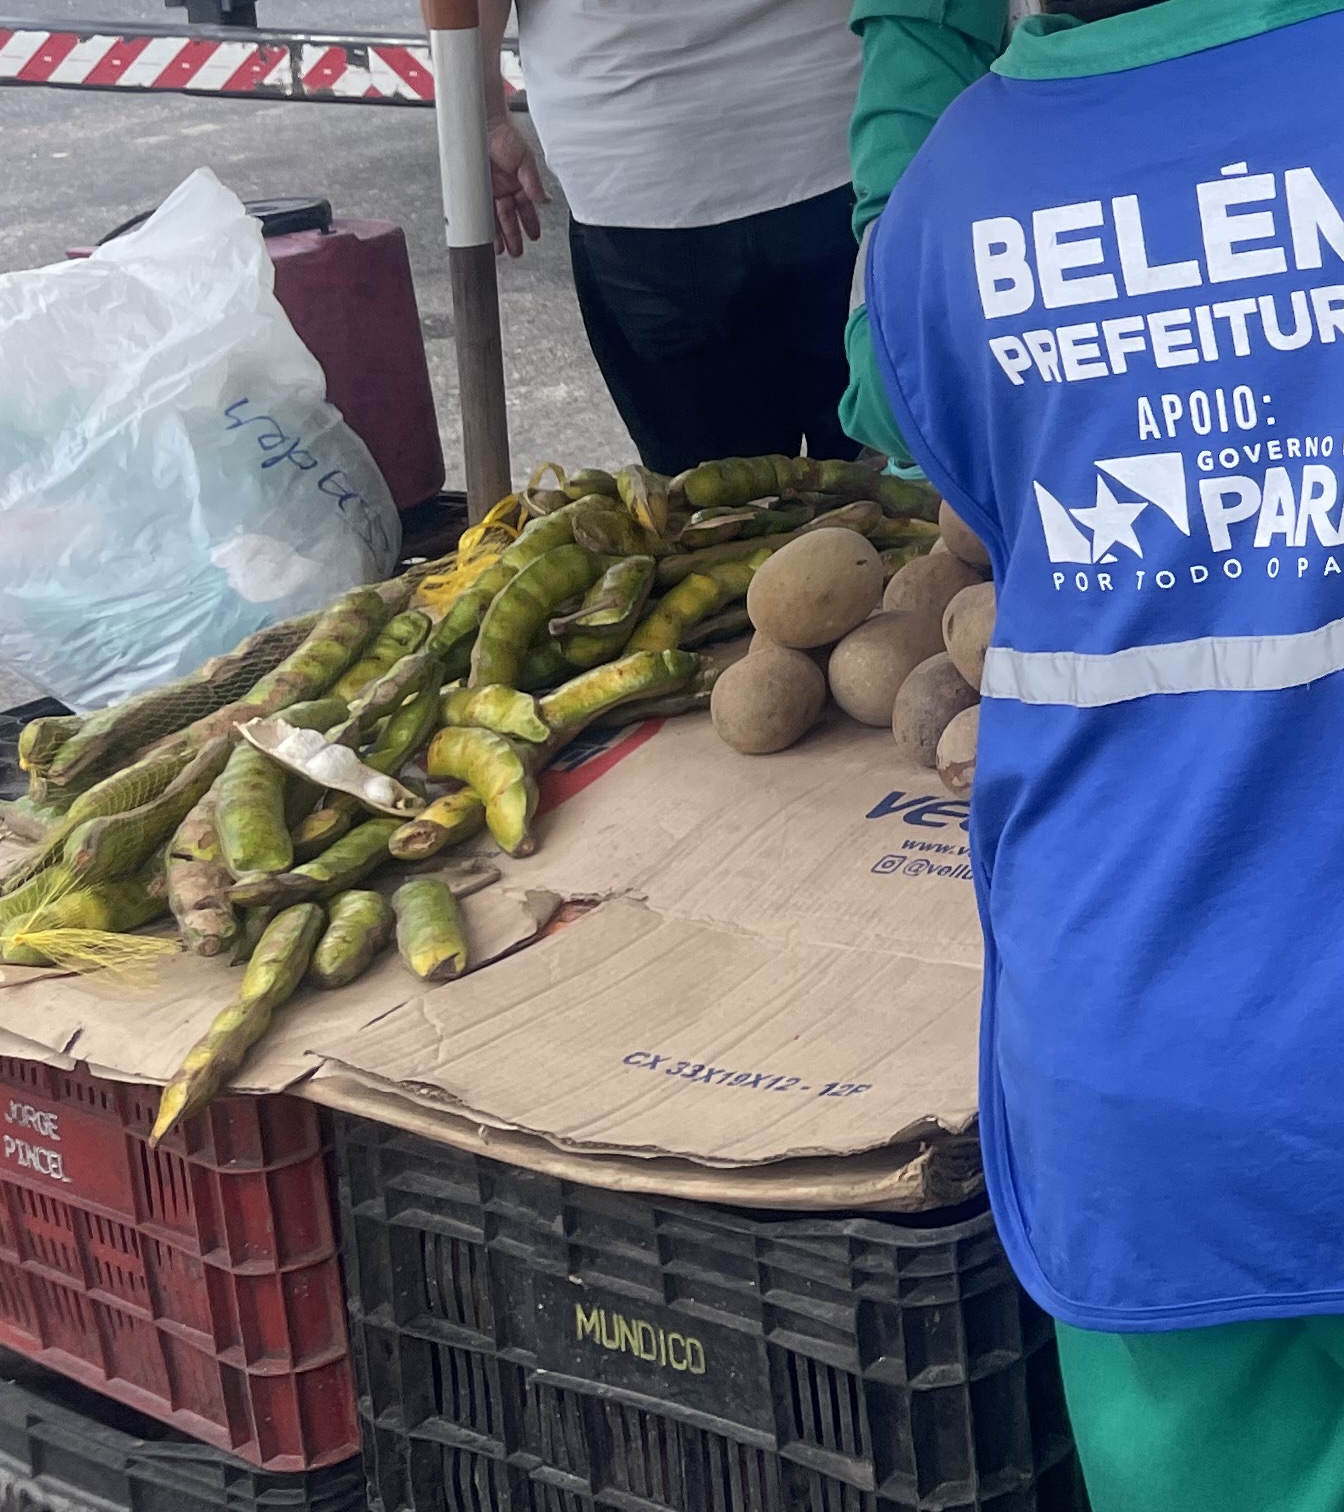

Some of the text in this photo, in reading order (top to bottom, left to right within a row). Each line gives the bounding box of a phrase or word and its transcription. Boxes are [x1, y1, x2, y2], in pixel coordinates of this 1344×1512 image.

[1137, 385, 1277, 441] APOIO:
[1197, 436, 1334, 472] GOVERNO
[1053, 570, 1114, 592] POR
[1134, 559, 1243, 591] TODO
[1266, 557, 1281, 578] O
[623, 1051, 670, 1070] CX
[575, 1303, 706, 1375] MUNDICO
